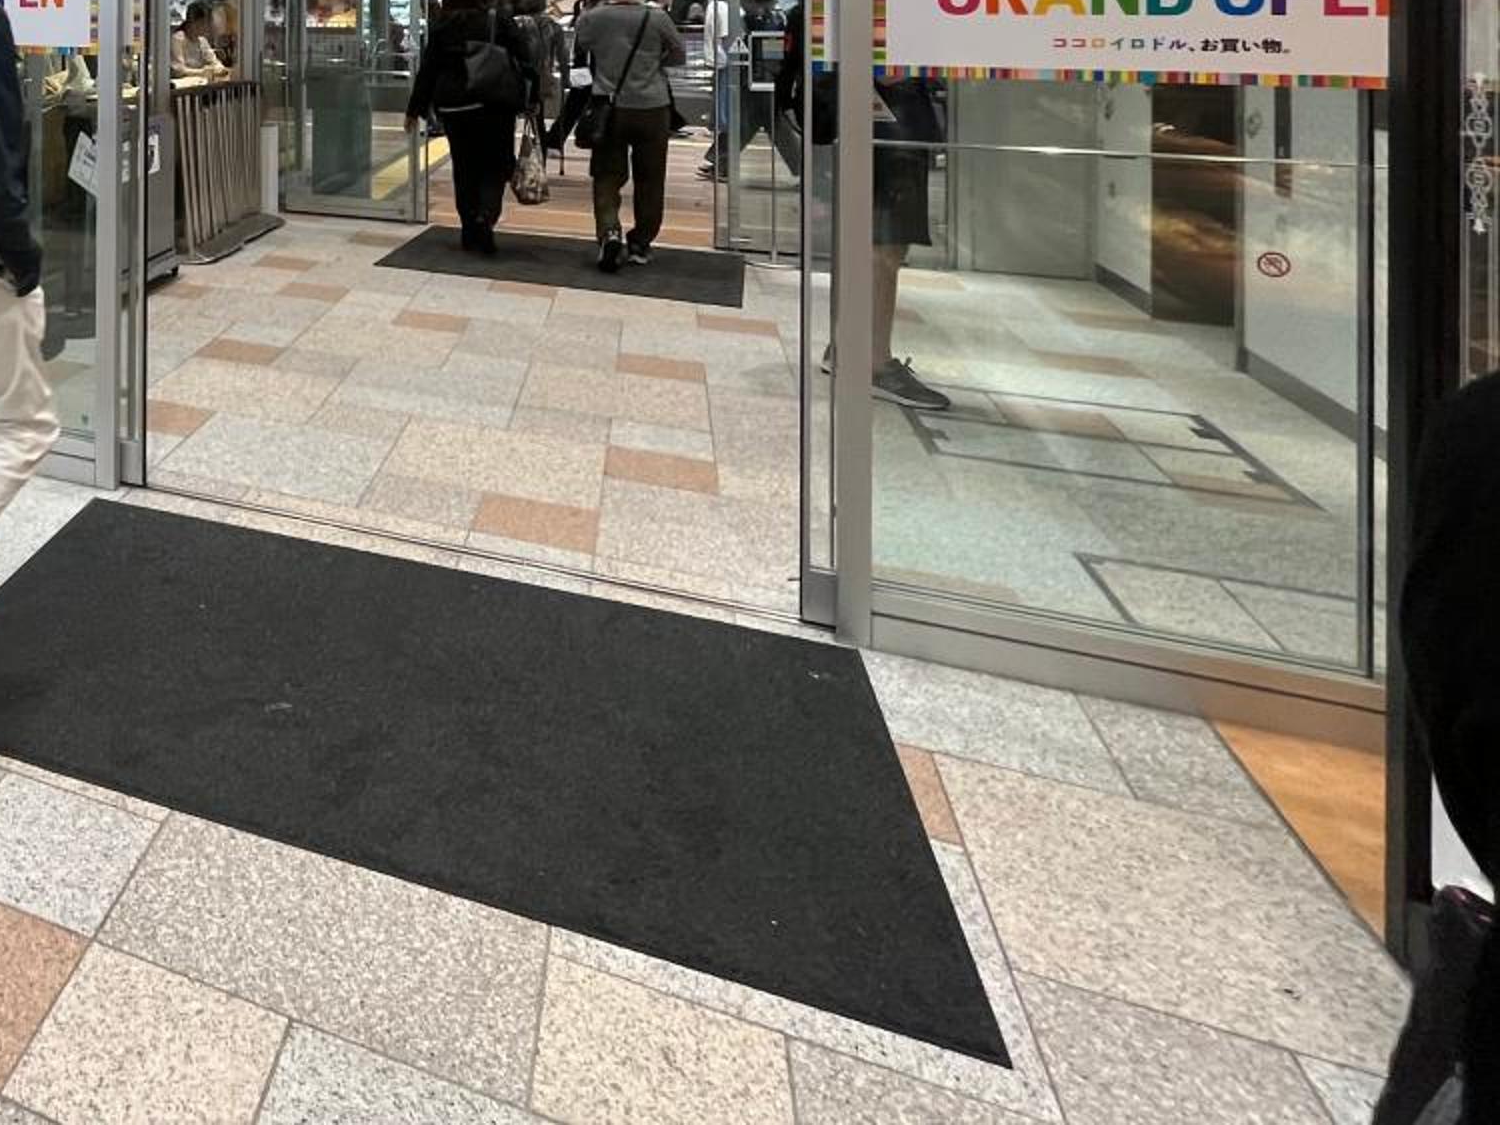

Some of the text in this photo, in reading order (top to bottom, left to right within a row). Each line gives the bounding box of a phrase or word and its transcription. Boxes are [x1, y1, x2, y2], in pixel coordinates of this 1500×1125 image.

[1053, 37, 1292, 54] ココロイロドル、お買い物。
